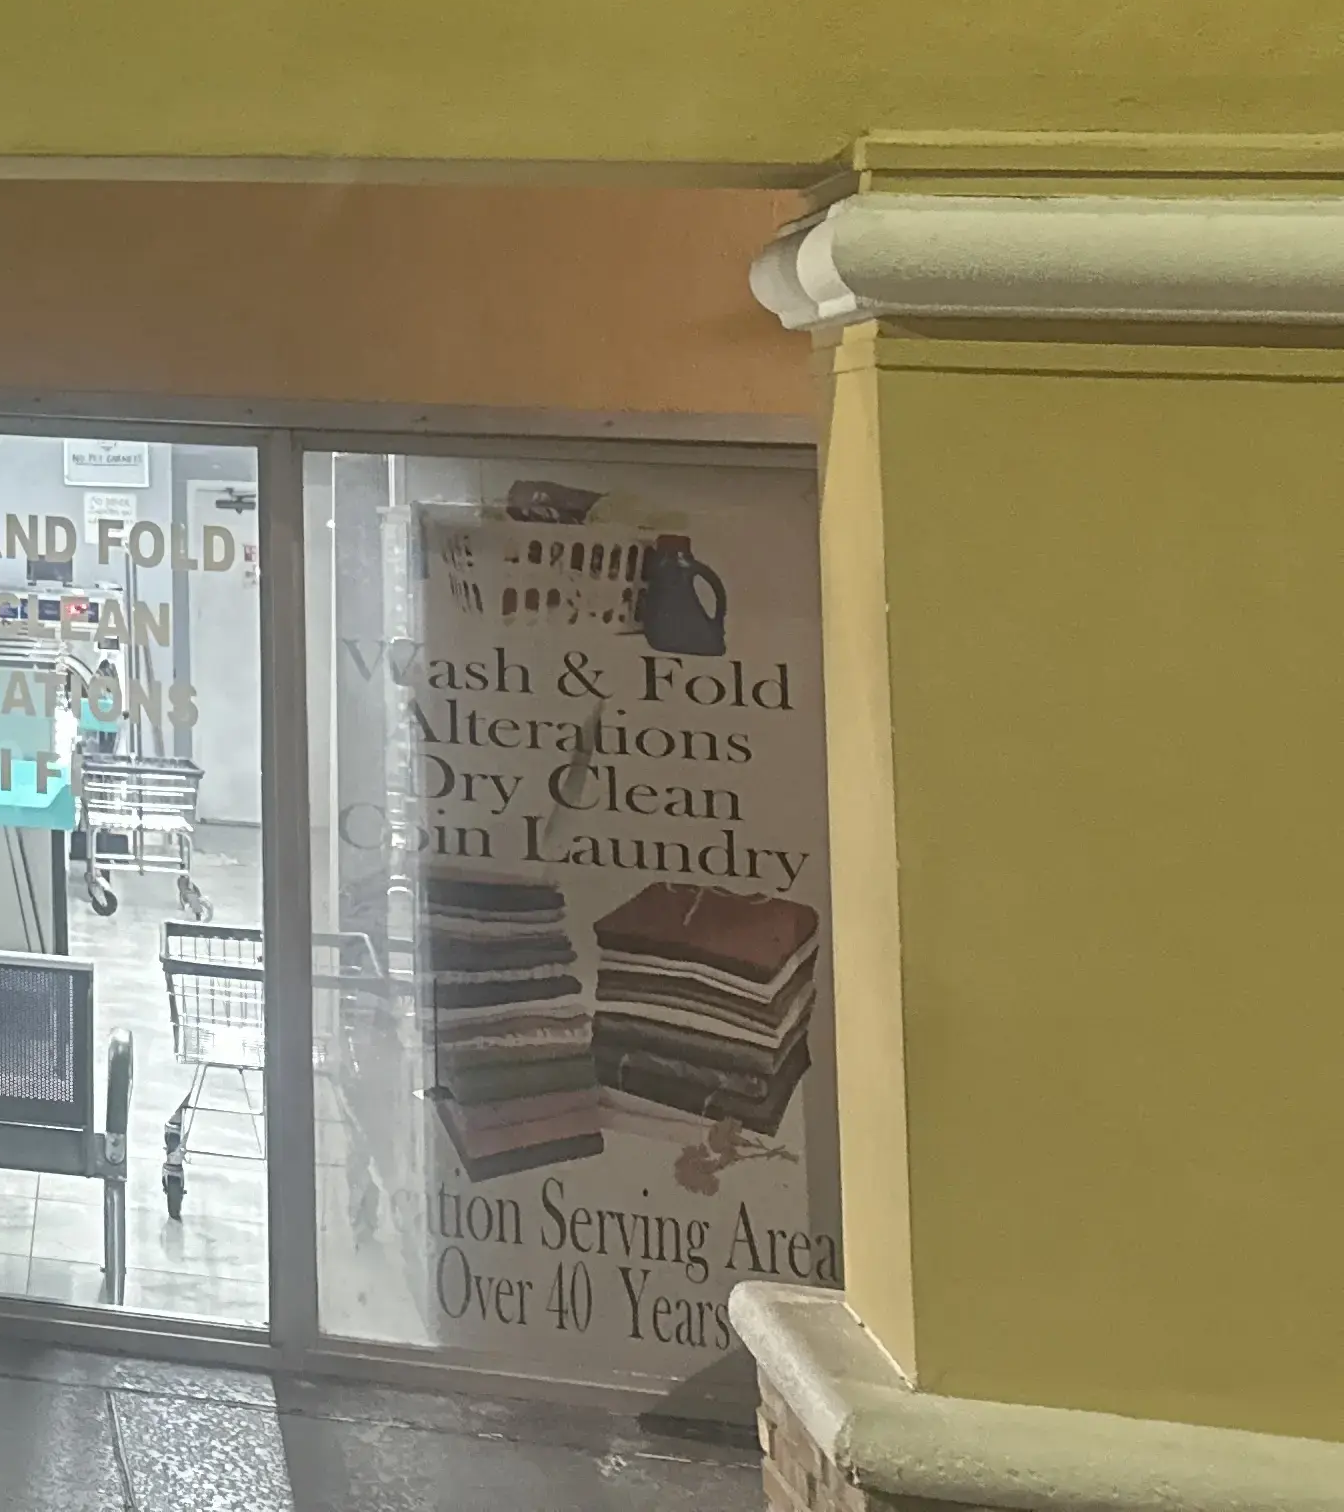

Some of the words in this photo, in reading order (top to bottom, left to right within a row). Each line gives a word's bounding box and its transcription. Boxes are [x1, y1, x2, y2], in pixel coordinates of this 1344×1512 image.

[98, 519, 235, 573] FOLD
[557, 650, 613, 700] &
[640, 655, 796, 711] Fold
[547, 760, 745, 822] Clean
[522, 814, 811, 892] Laundry
[540, 1177, 711, 1283] Serving
[724, 1201, 840, 1282] Area
[436, 1245, 533, 1327] Over
[545, 1260, 593, 1333] 40
[618, 1266, 730, 1351] Years
